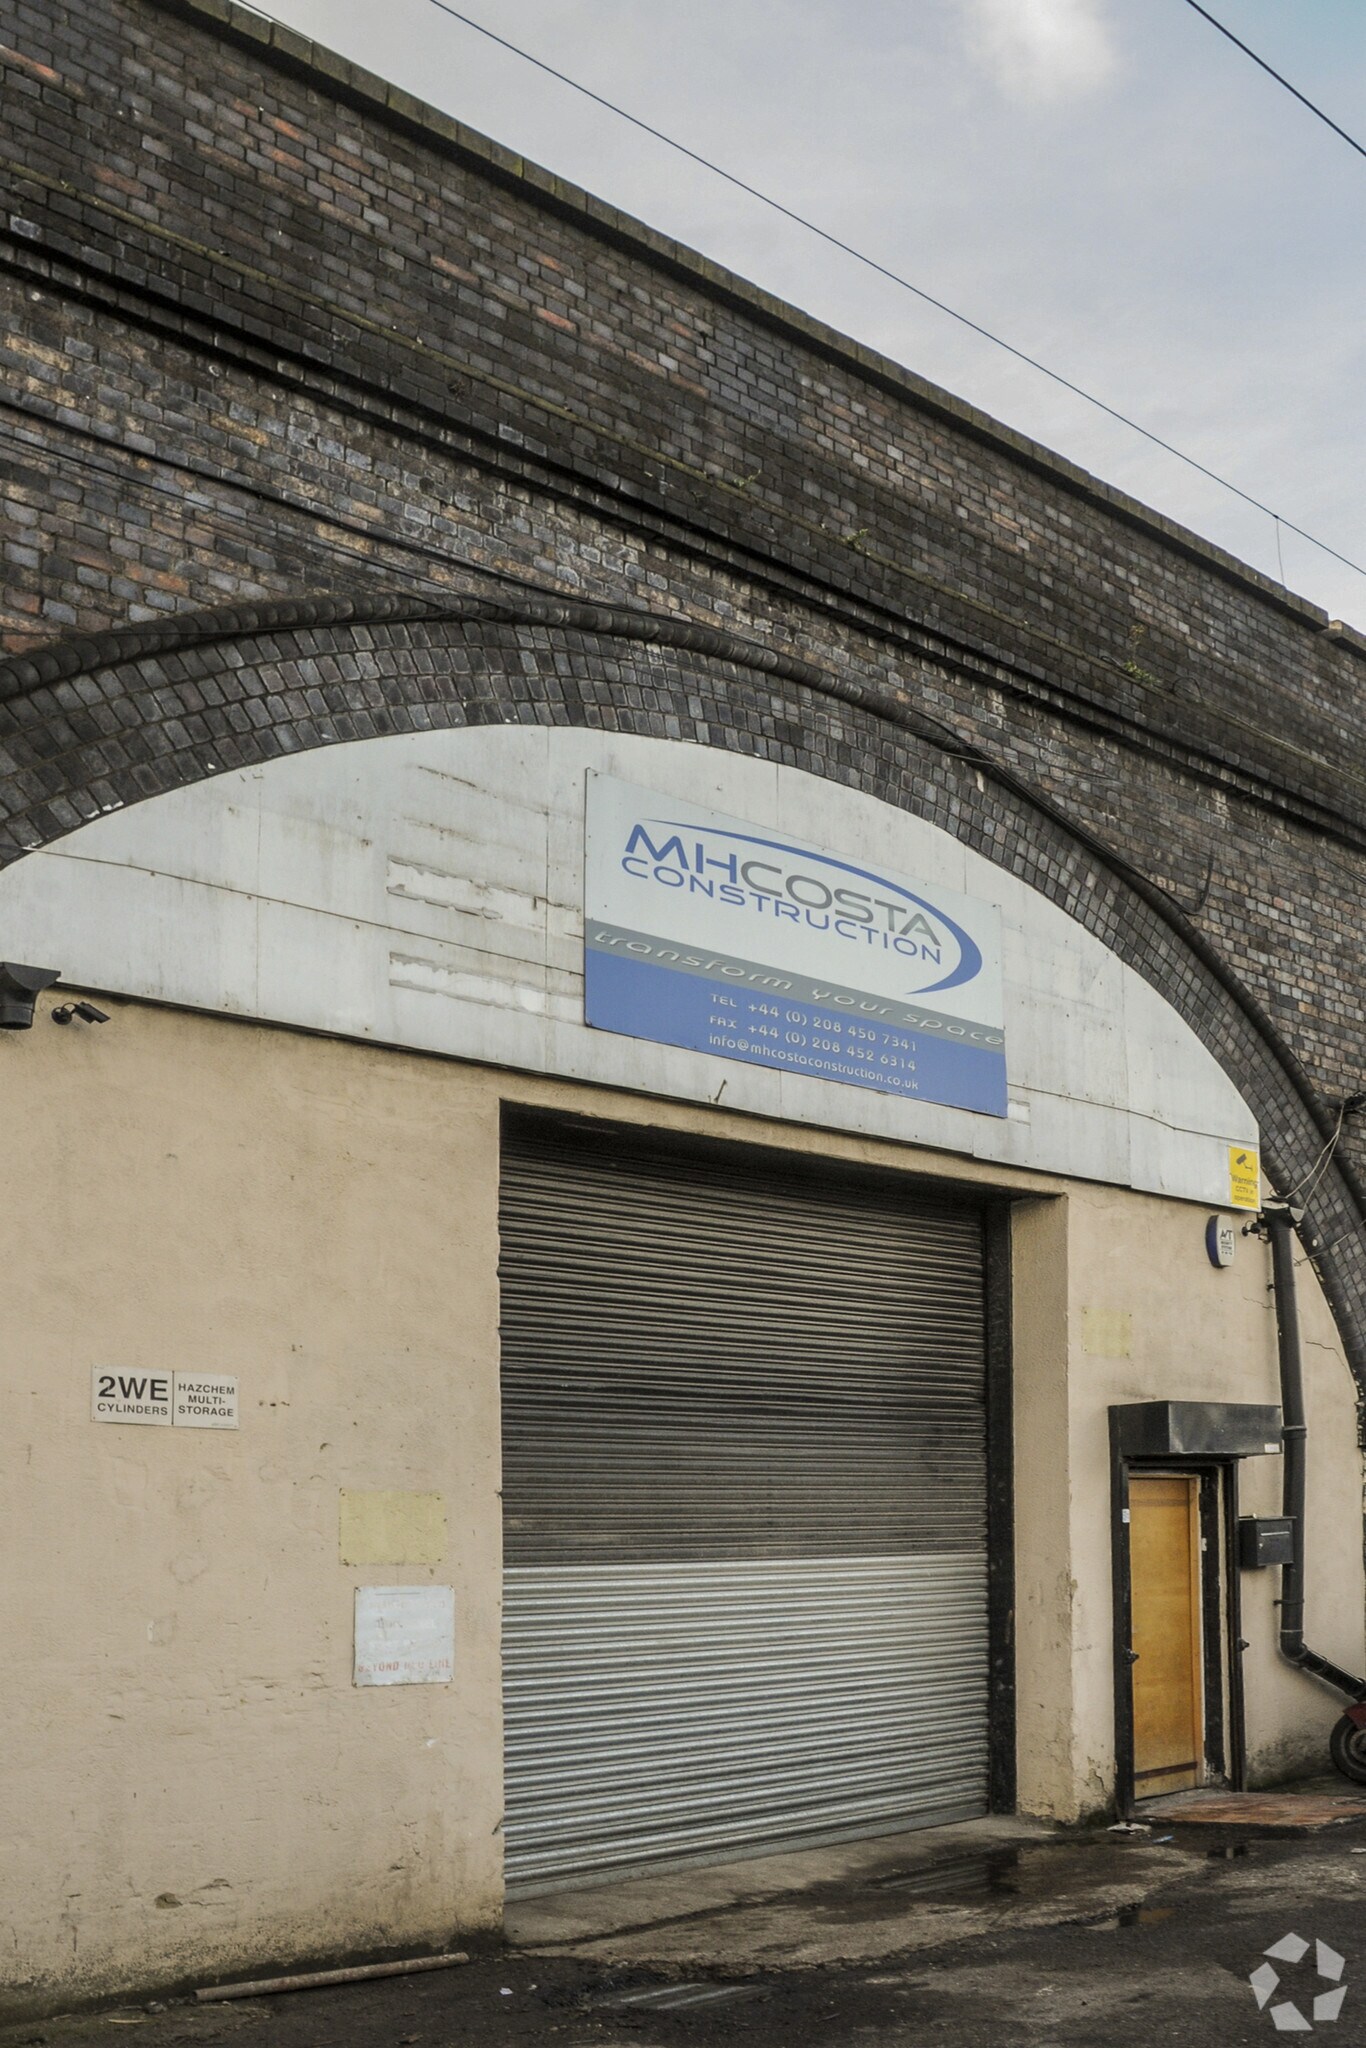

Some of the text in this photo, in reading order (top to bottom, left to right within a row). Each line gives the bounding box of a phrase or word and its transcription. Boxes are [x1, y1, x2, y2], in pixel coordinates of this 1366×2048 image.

[621, 856, 941, 965] CONSTRUCTION
[594, 931, 1004, 1045] transform your space
[710, 993, 917, 1052] TEL +44 (0) 208 450 7341
[709, 1015, 917, 1071] FAX +44 (0) 208 452 6314
[708, 1033, 919, 1090] info@mhcostaconstruction.co.uk
[1231, 1174, 1259, 1189] Warning
[98, 1375, 169, 1402] 2WE
[178, 1383, 235, 1395] HAZCHEM
[188, 1395, 226, 1405] MULTI-
[97, 1402, 168, 1416] CYLINDERS
[178, 1405, 234, 1417] STORAGE
